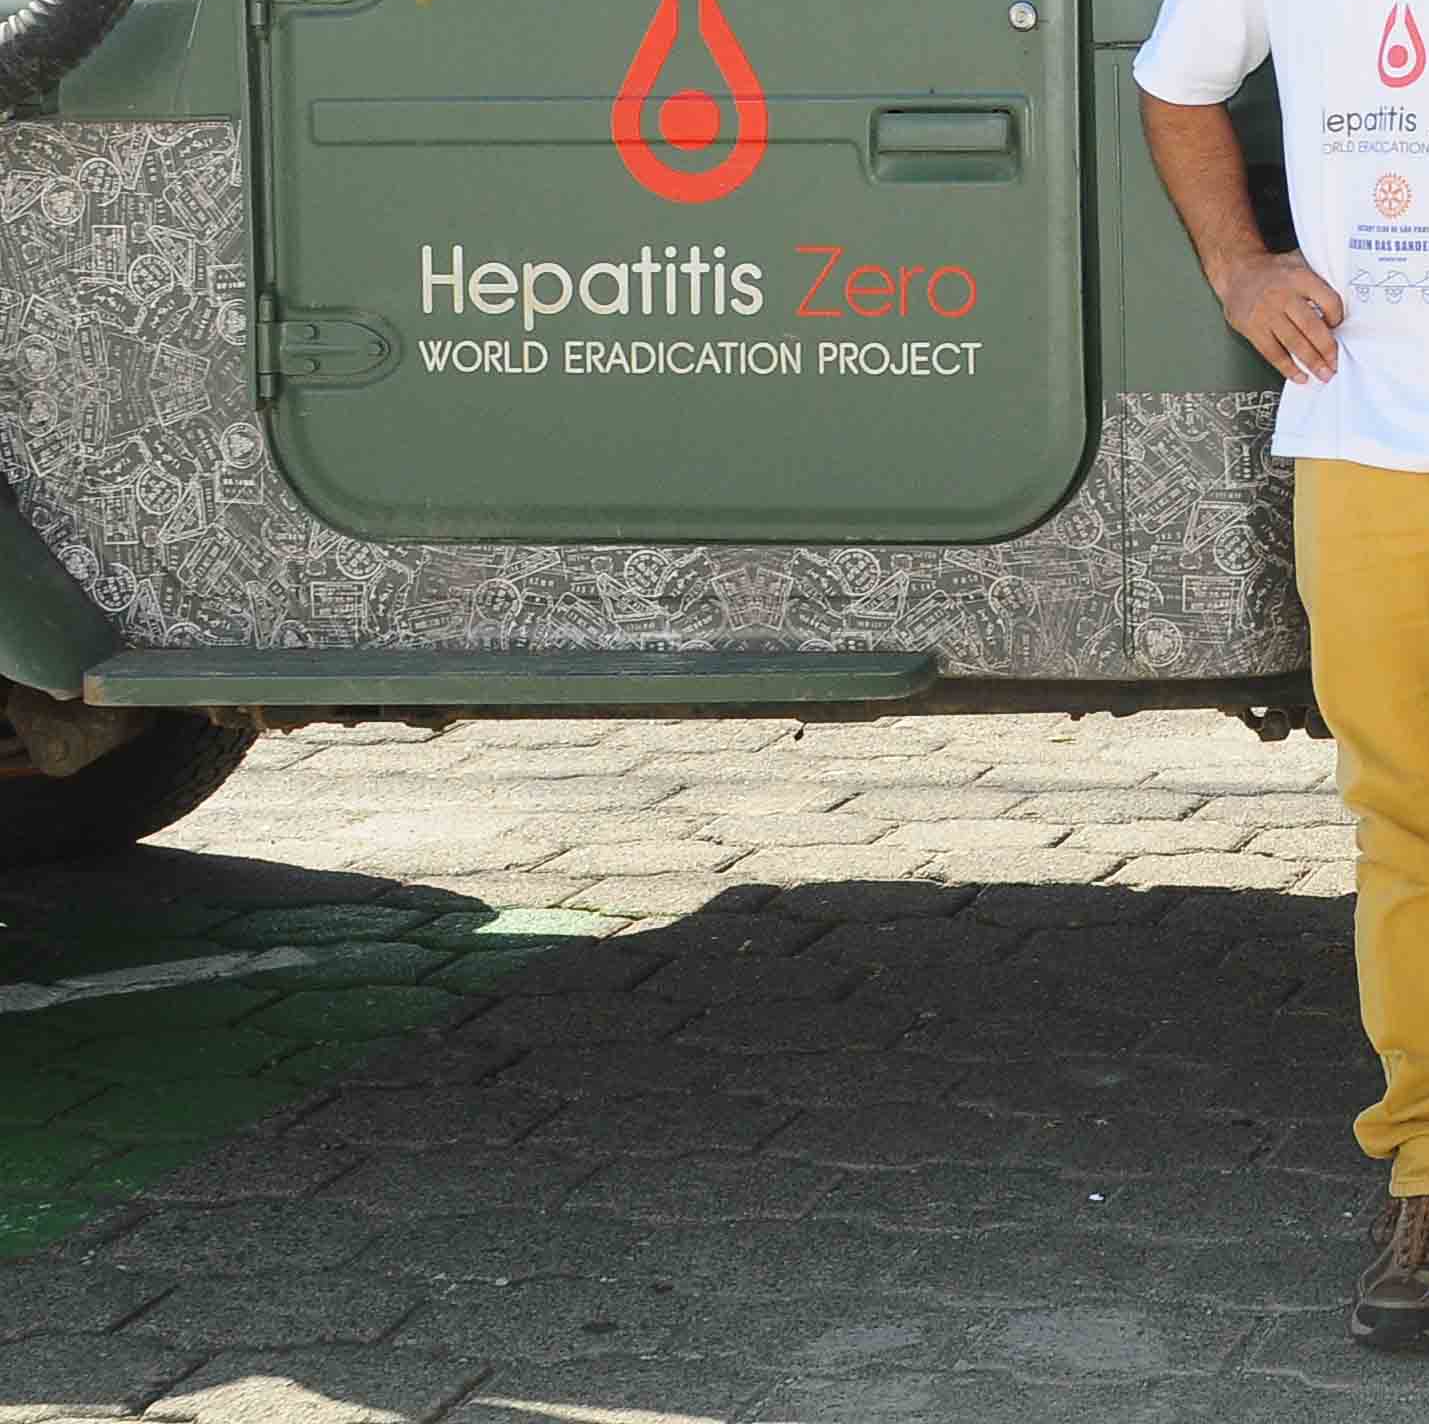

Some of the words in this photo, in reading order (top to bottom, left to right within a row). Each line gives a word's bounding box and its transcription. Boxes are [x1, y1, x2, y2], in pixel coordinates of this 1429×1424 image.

[420, 244, 764, 332] Hepatitis
[794, 246, 978, 320] Zero
[419, 340, 548, 375] WORLD
[565, 341, 802, 375] ERADICATION
[818, 342, 982, 376] PROJECT
